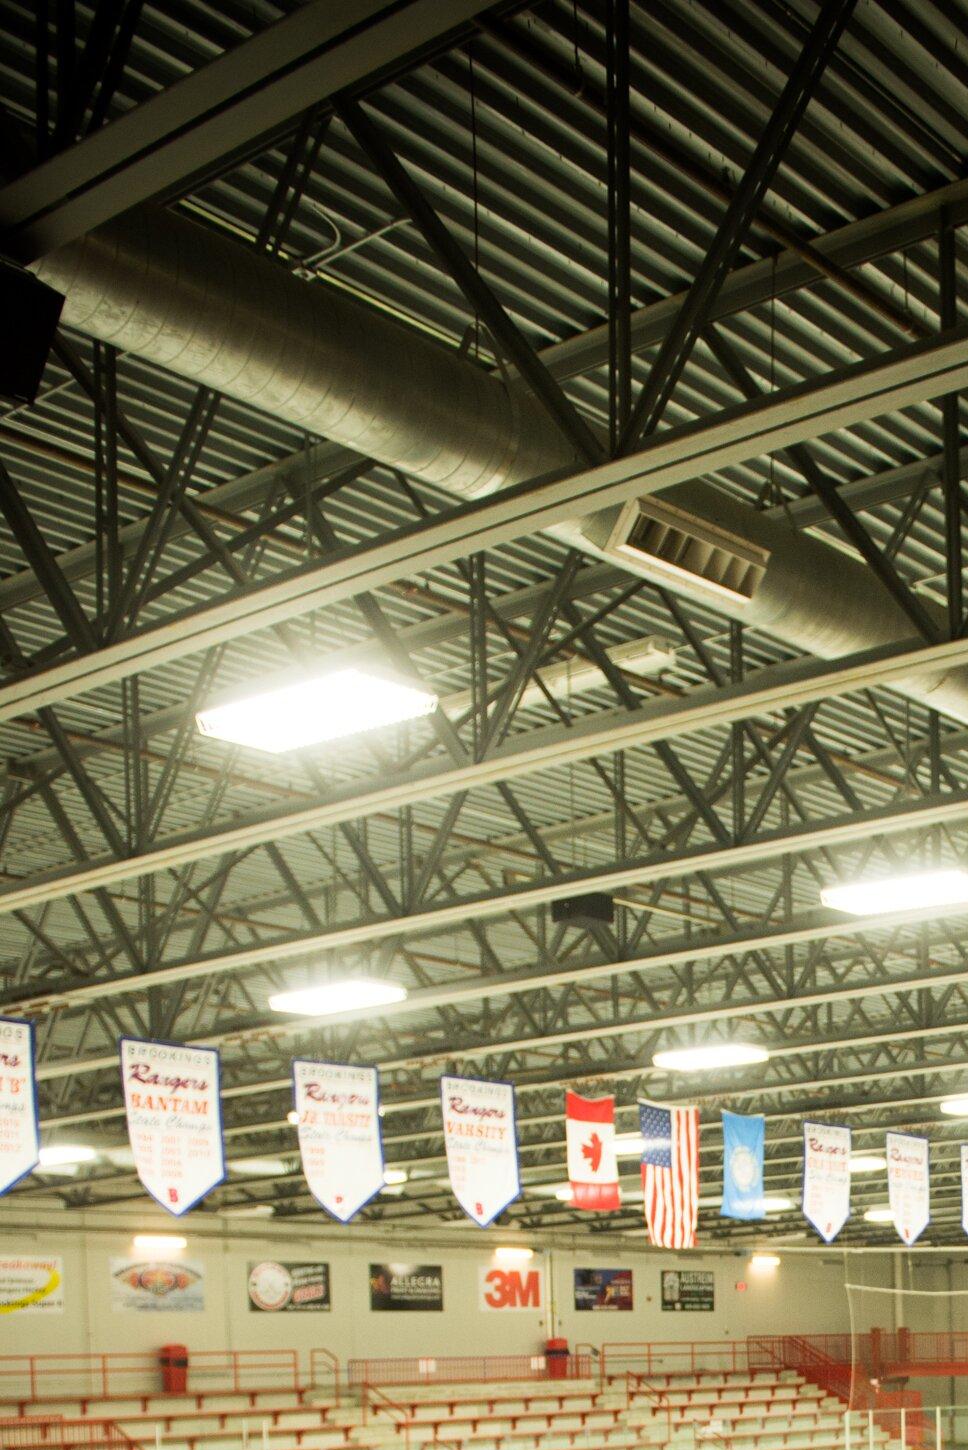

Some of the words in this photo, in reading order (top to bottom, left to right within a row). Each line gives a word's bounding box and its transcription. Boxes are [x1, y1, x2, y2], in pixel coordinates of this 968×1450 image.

[130, 1064, 208, 1093] Rangers
[131, 1093, 208, 1115] BANTAM
[450, 1097, 505, 1119] Rangers
[447, 1121, 506, 1140] VARSITY
[168, 1188, 178, 1202] B
[485, 1269, 540, 1308] 3M
